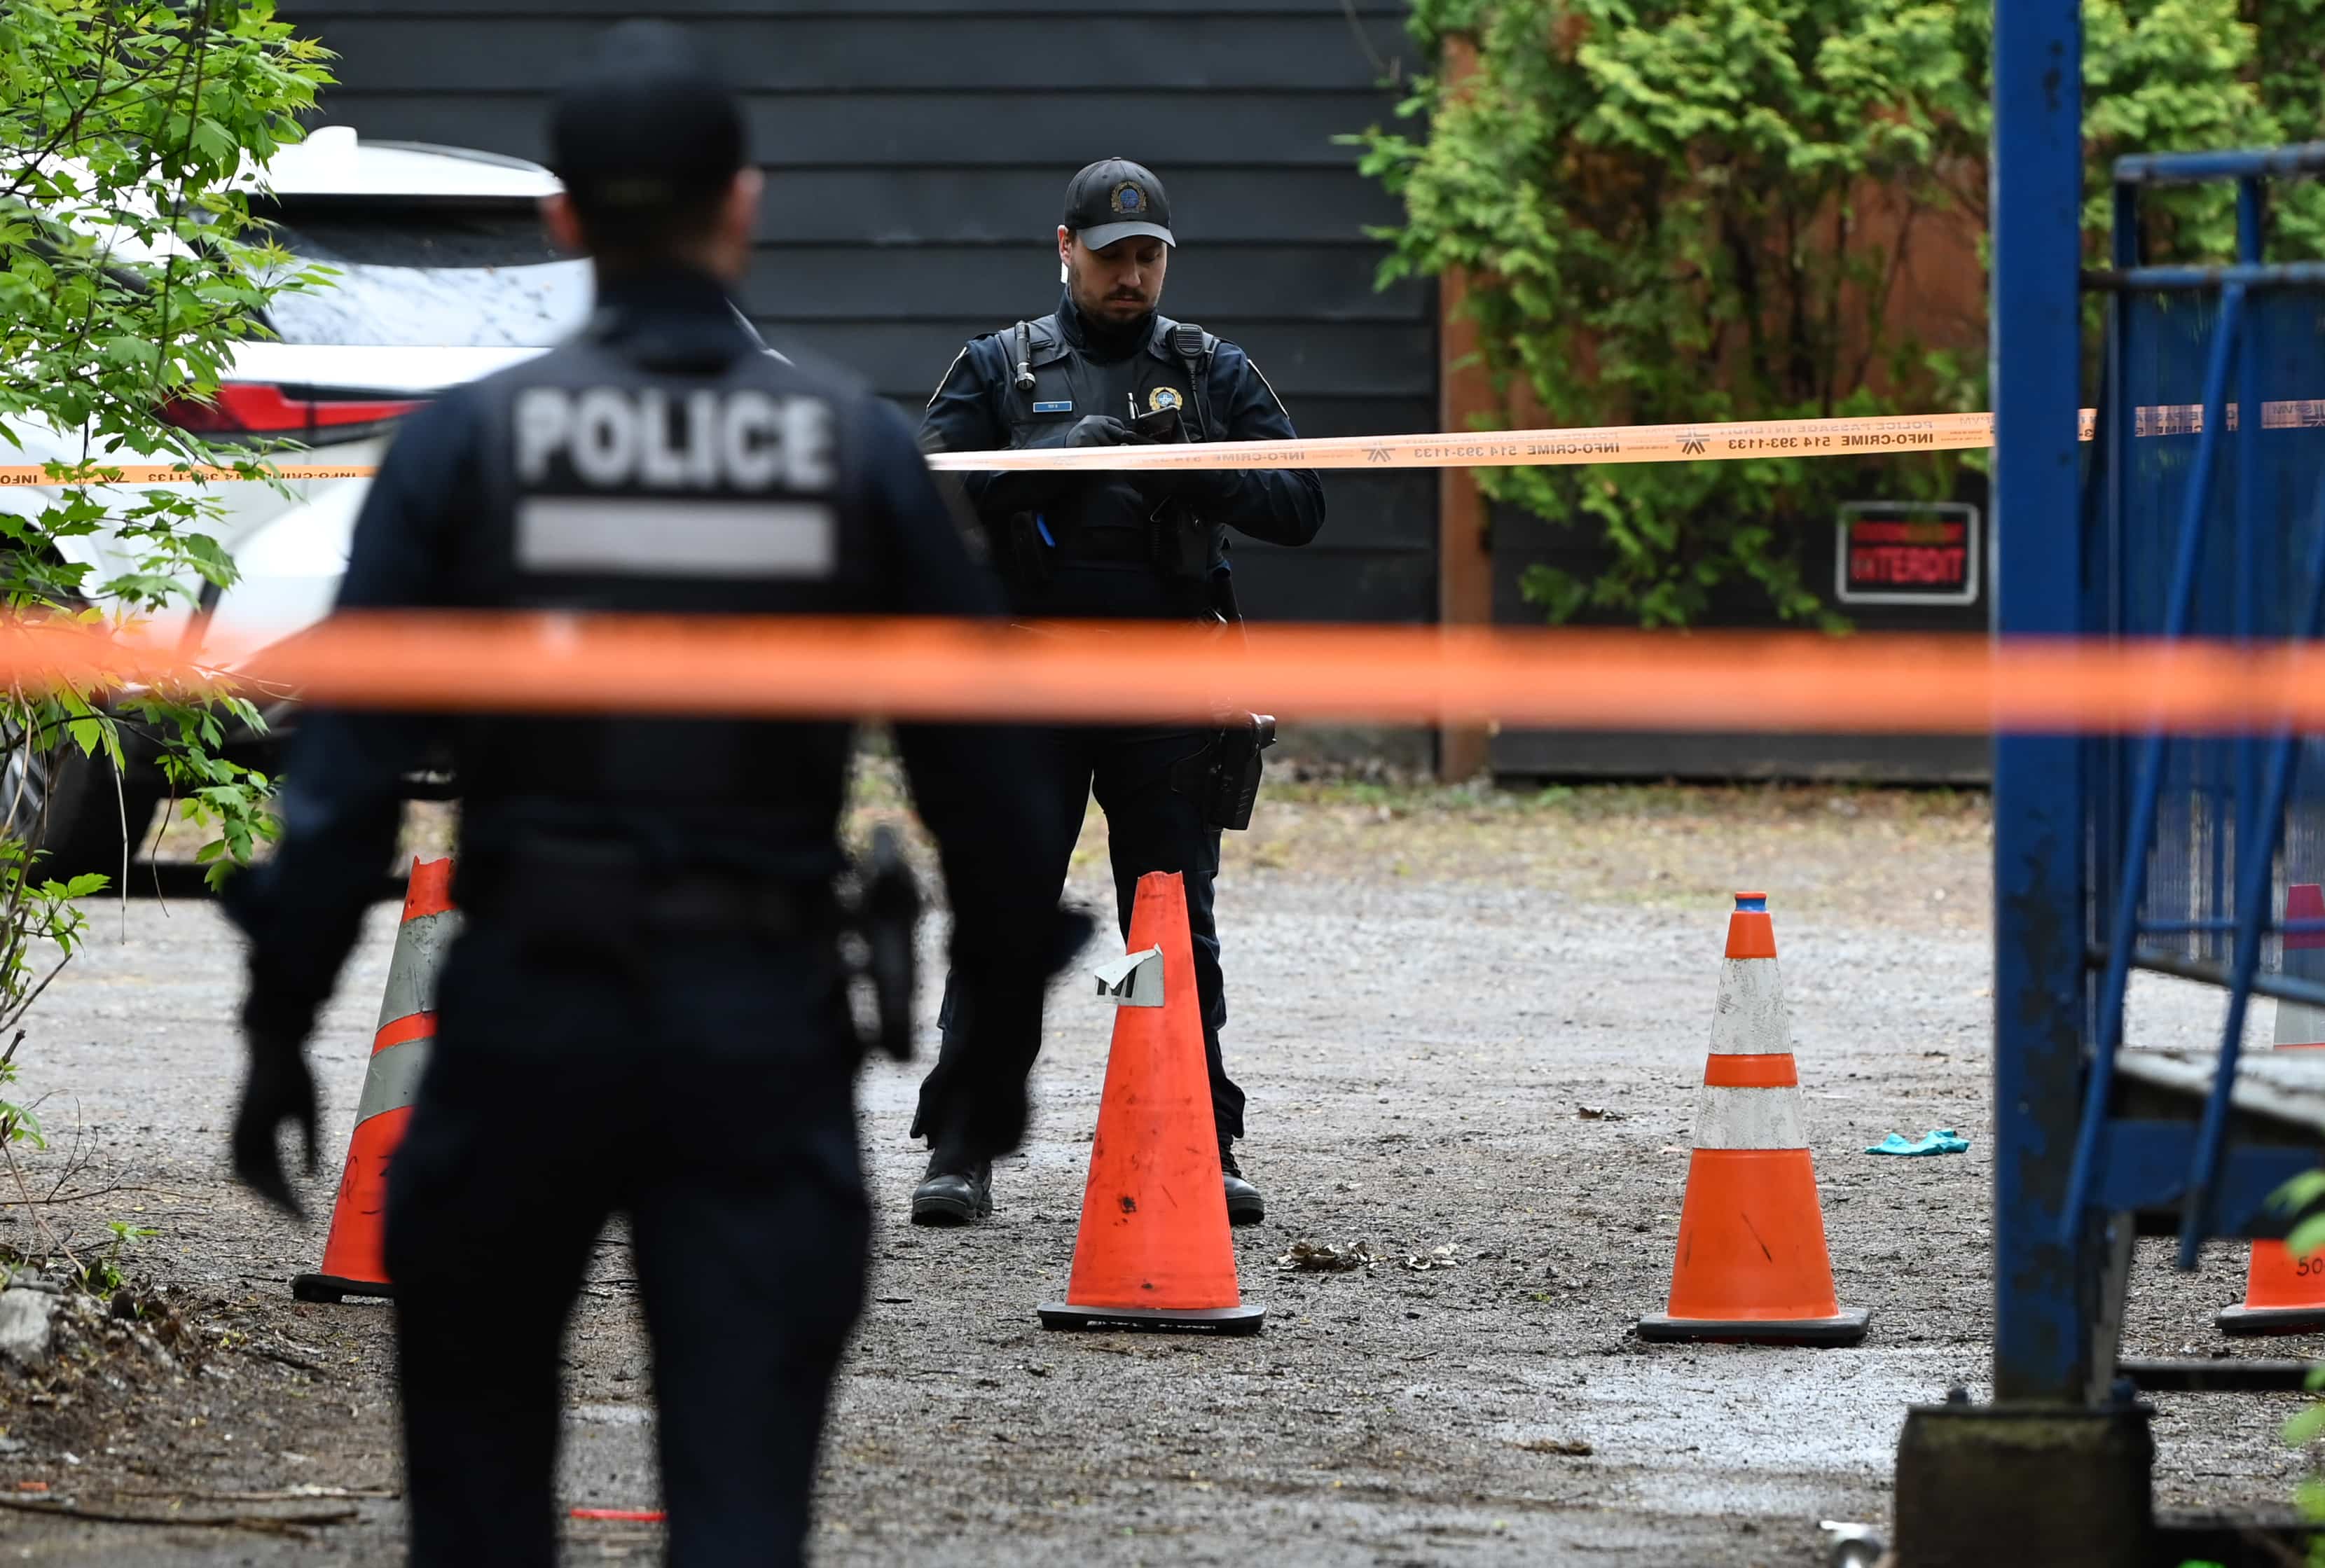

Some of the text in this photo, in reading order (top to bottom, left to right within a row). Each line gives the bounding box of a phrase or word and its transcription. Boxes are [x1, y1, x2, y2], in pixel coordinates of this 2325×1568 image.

[516, 385, 834, 489] POLICE
[0, 475, 38, 484] INFO
[148, 473, 218, 482] 39-1133
